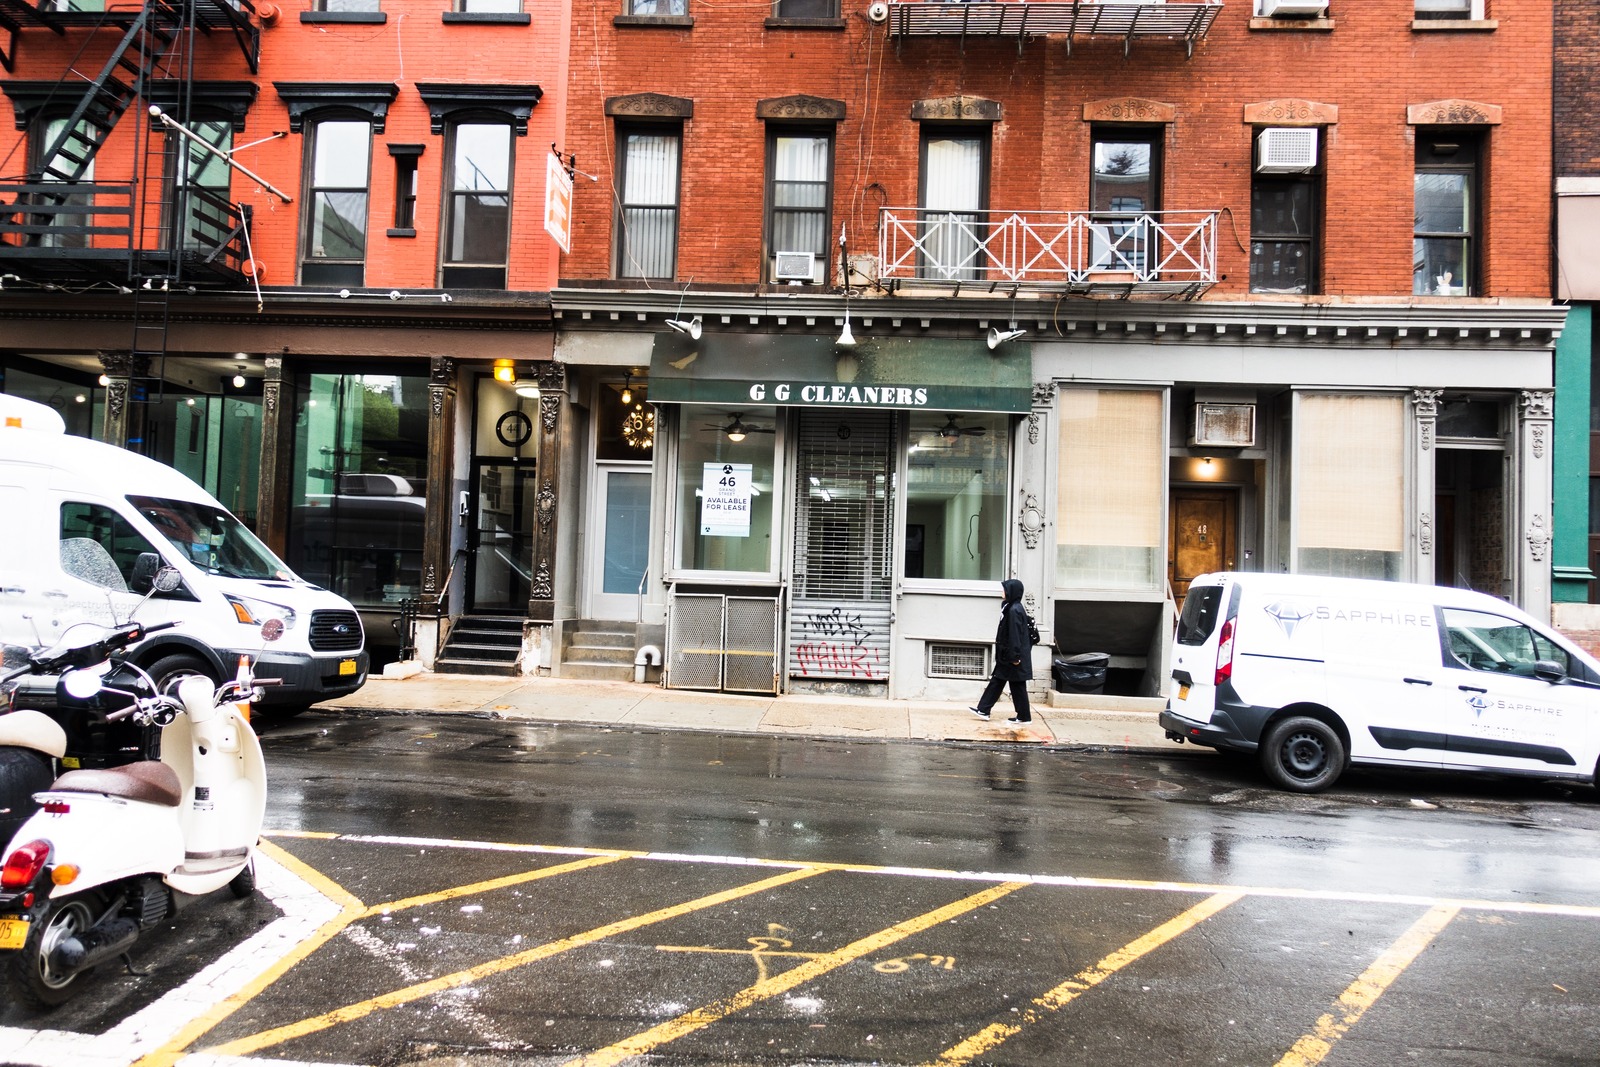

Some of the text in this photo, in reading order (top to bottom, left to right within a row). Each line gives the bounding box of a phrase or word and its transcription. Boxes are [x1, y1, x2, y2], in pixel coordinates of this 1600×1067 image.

[749, 384, 928, 405] G G CLEANERS
[719, 477, 736, 487] 46
[1197, 524, 1208, 534] 48
[63, 599, 138, 611] spectrumcom
